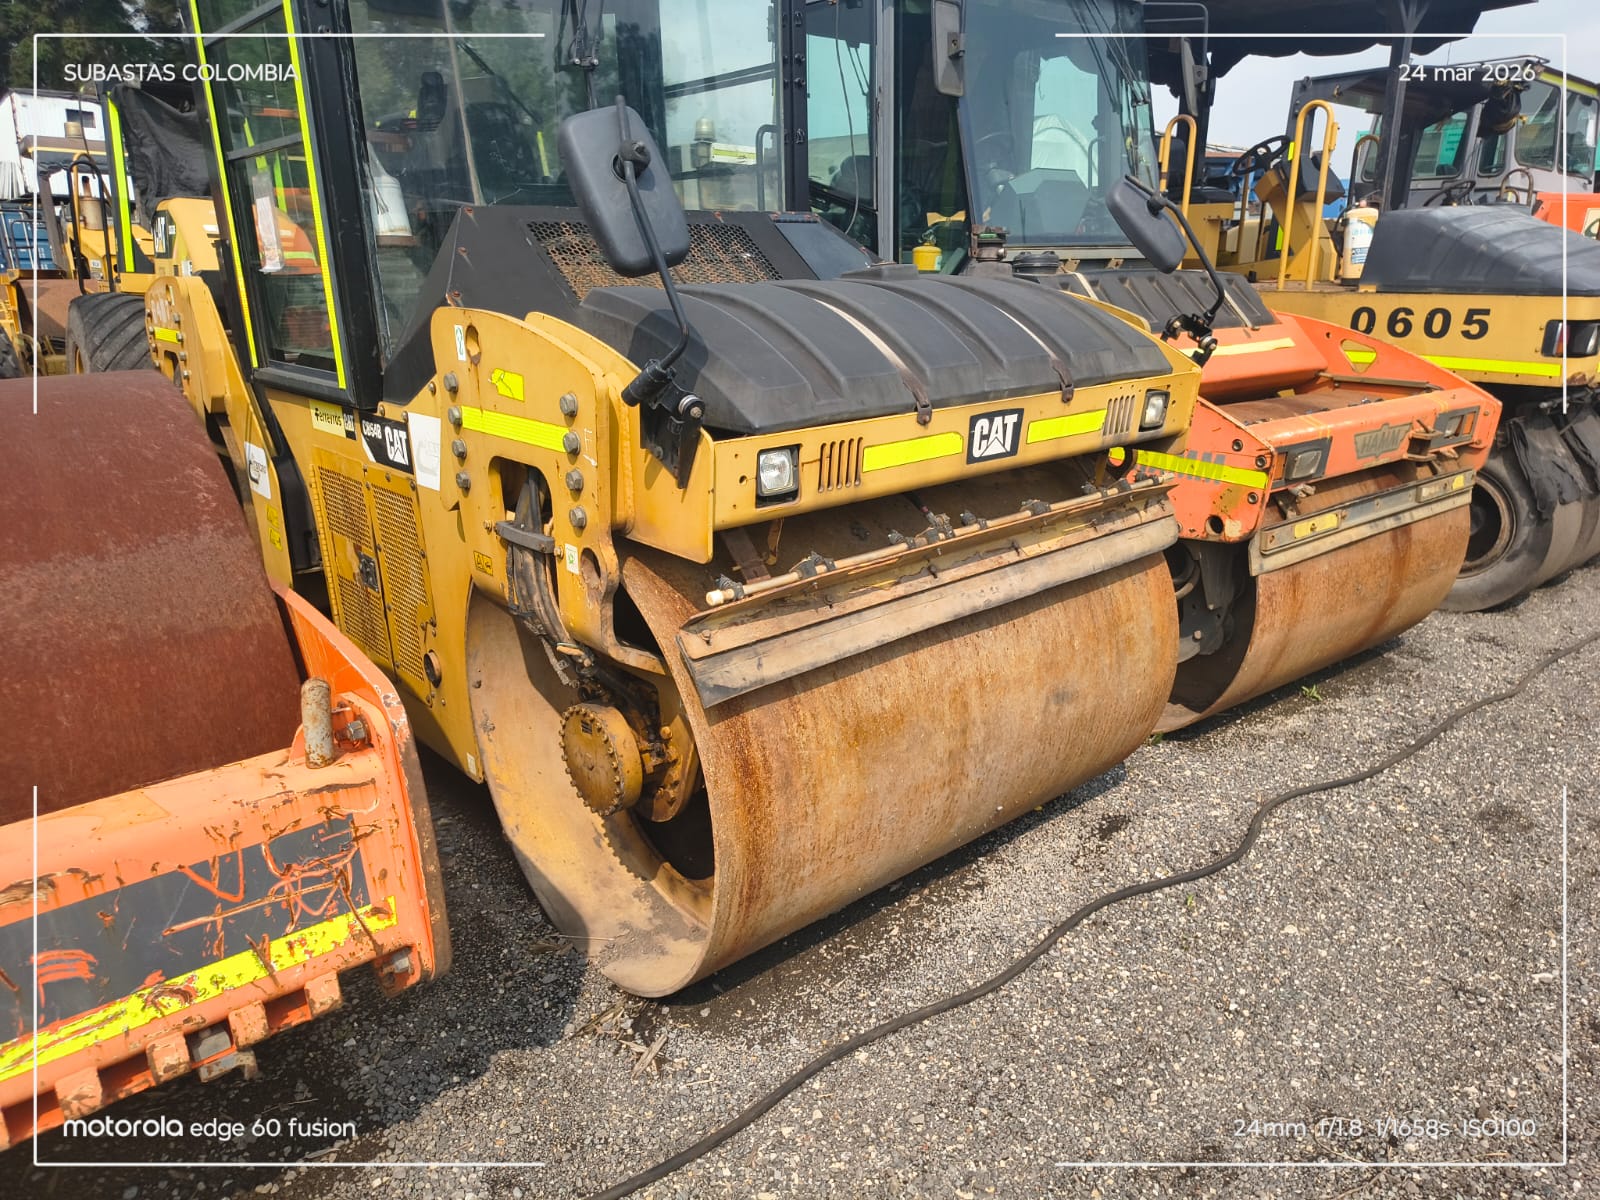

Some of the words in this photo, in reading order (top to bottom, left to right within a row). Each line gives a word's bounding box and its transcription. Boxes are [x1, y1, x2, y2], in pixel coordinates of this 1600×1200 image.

[1350, 306, 1491, 340] 0605
[344, 413, 355, 432] CAT
[972, 413, 1019, 458] CAT
[384, 425, 409, 466] CAT
